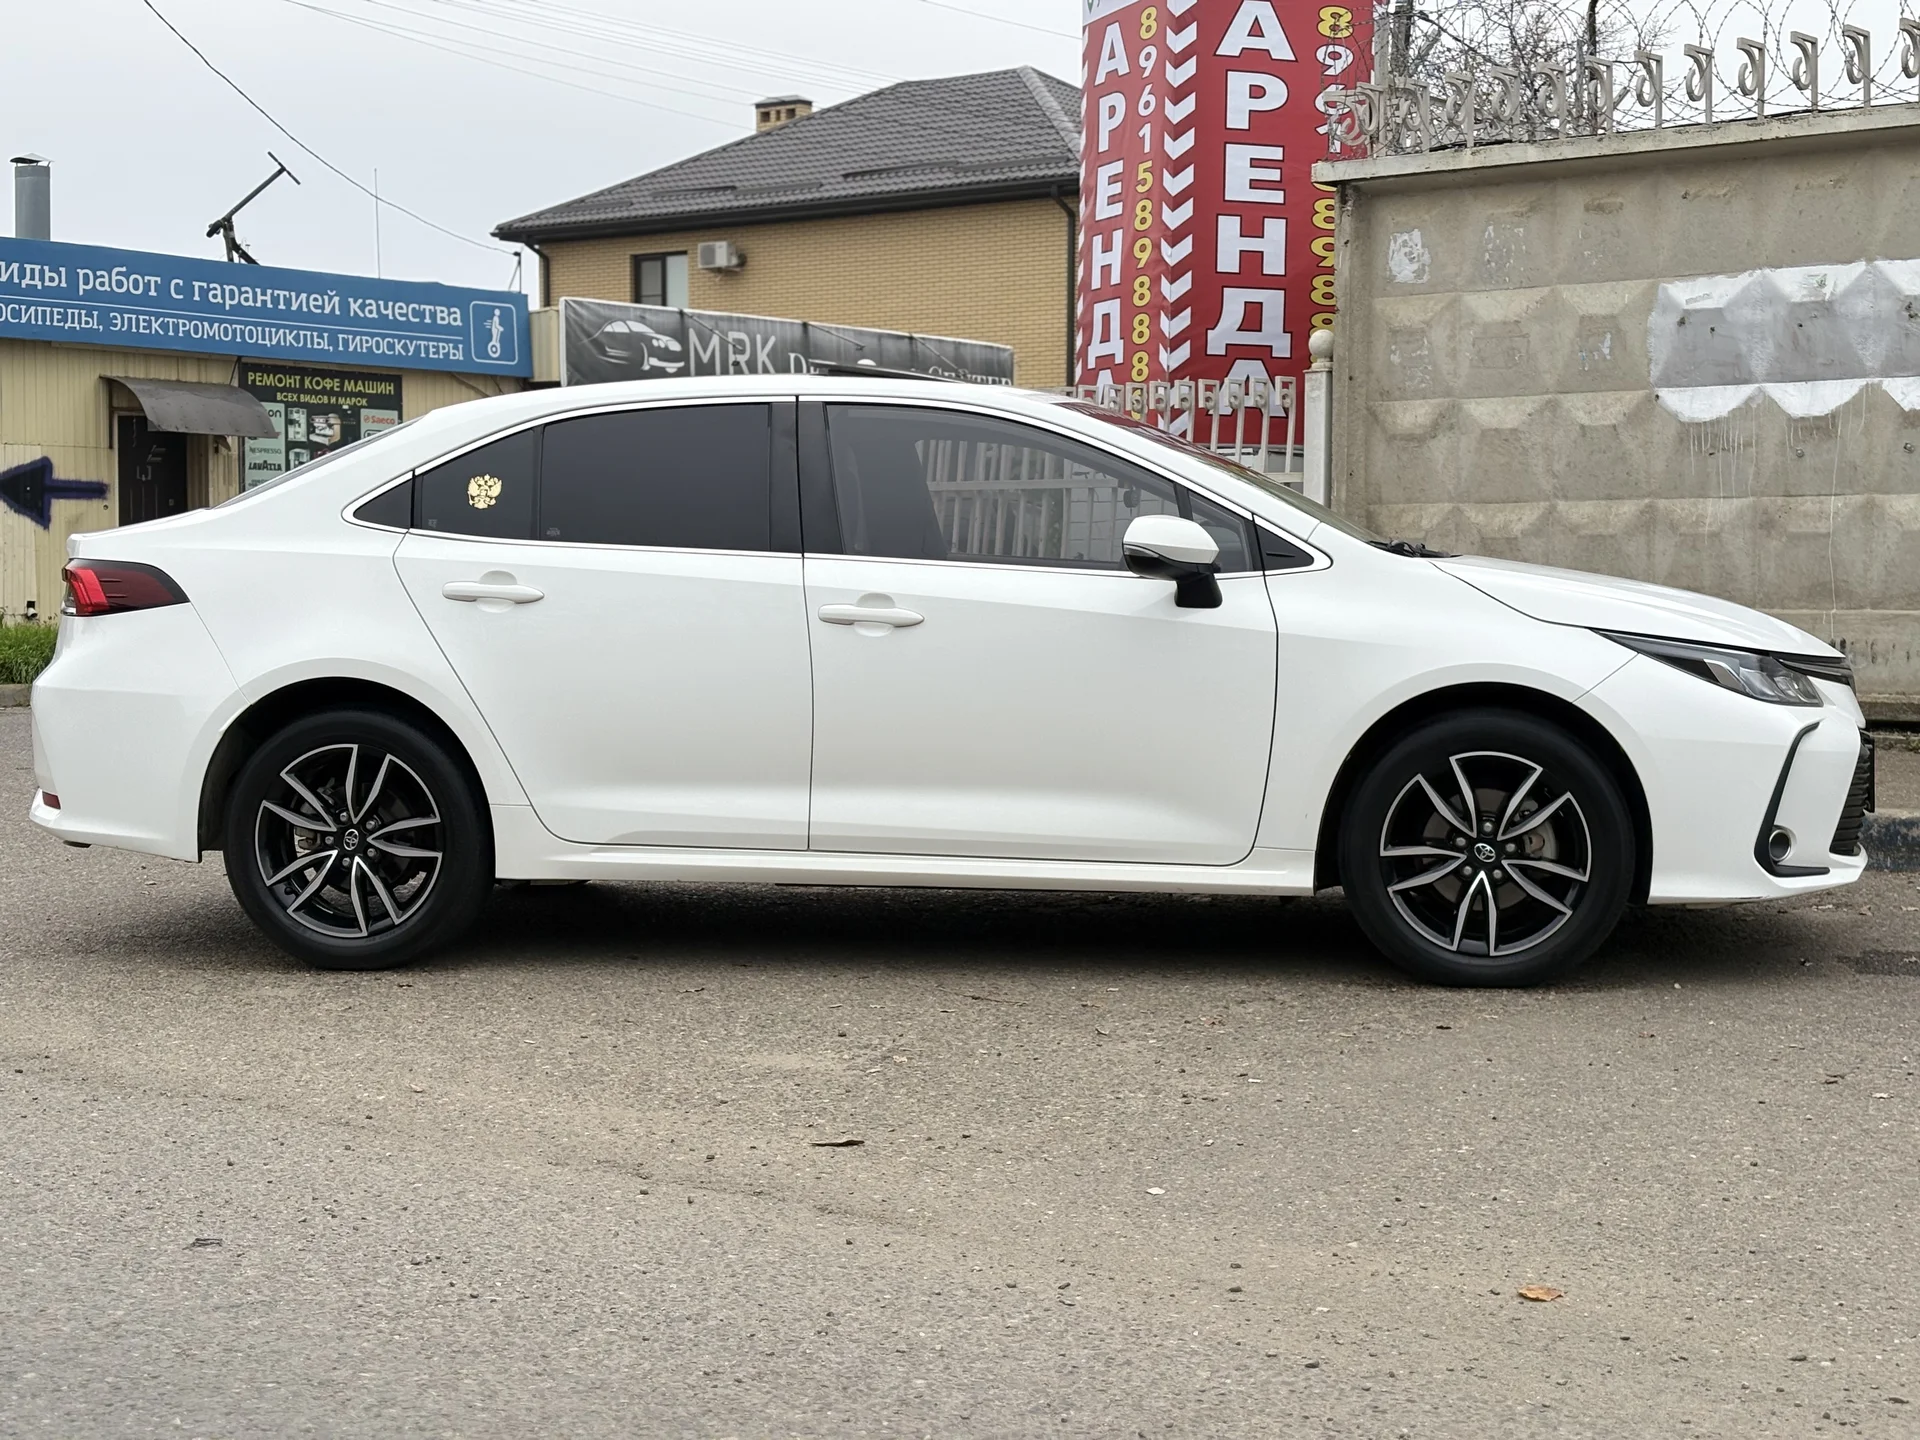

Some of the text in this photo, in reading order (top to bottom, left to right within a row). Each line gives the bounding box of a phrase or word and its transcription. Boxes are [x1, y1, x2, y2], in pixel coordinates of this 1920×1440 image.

[1205, 0, 1299, 418] АРЕНДА
[76, 266, 161, 296] работ
[170, 278, 184, 299] с
[192, 280, 341, 316] гарантией
[347, 296, 463, 327] качества
[109, 312, 333, 353] ЭЛЕКТРОМОТОЦИКЛЫ,
[337, 333, 464, 361] ГИРОСКУТЕРЫ
[688, 327, 777, 377] MRK
[248, 371, 395, 396] РЕМОНТ КОФЕ МАШИН
[276, 392, 368, 407] ВСЕХ ВИДОВ И МАРОК
[371, 415, 396, 425] Saeco
[248, 460, 283, 472] LAVAZZA
